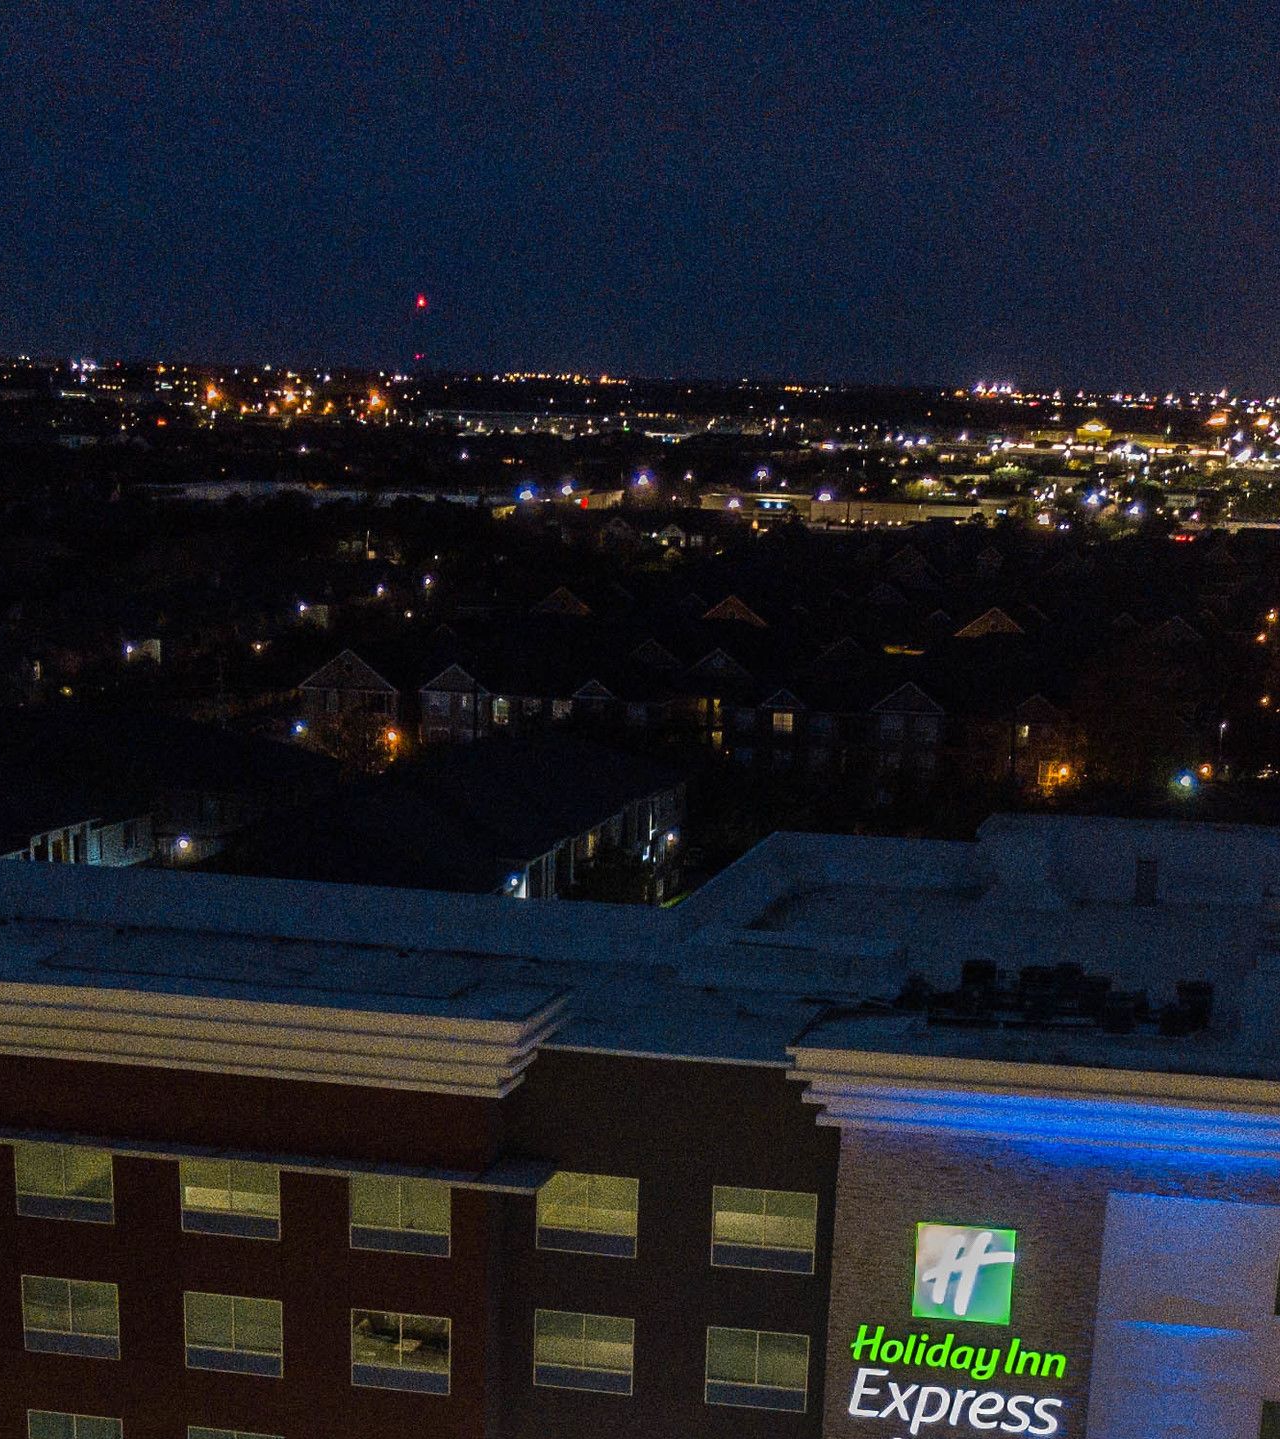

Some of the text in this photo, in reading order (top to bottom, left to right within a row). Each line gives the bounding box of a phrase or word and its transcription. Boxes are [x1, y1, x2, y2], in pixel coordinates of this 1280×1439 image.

[850, 1324, 1067, 1380] Holiday Inn
[848, 1367, 1062, 1435] Express
